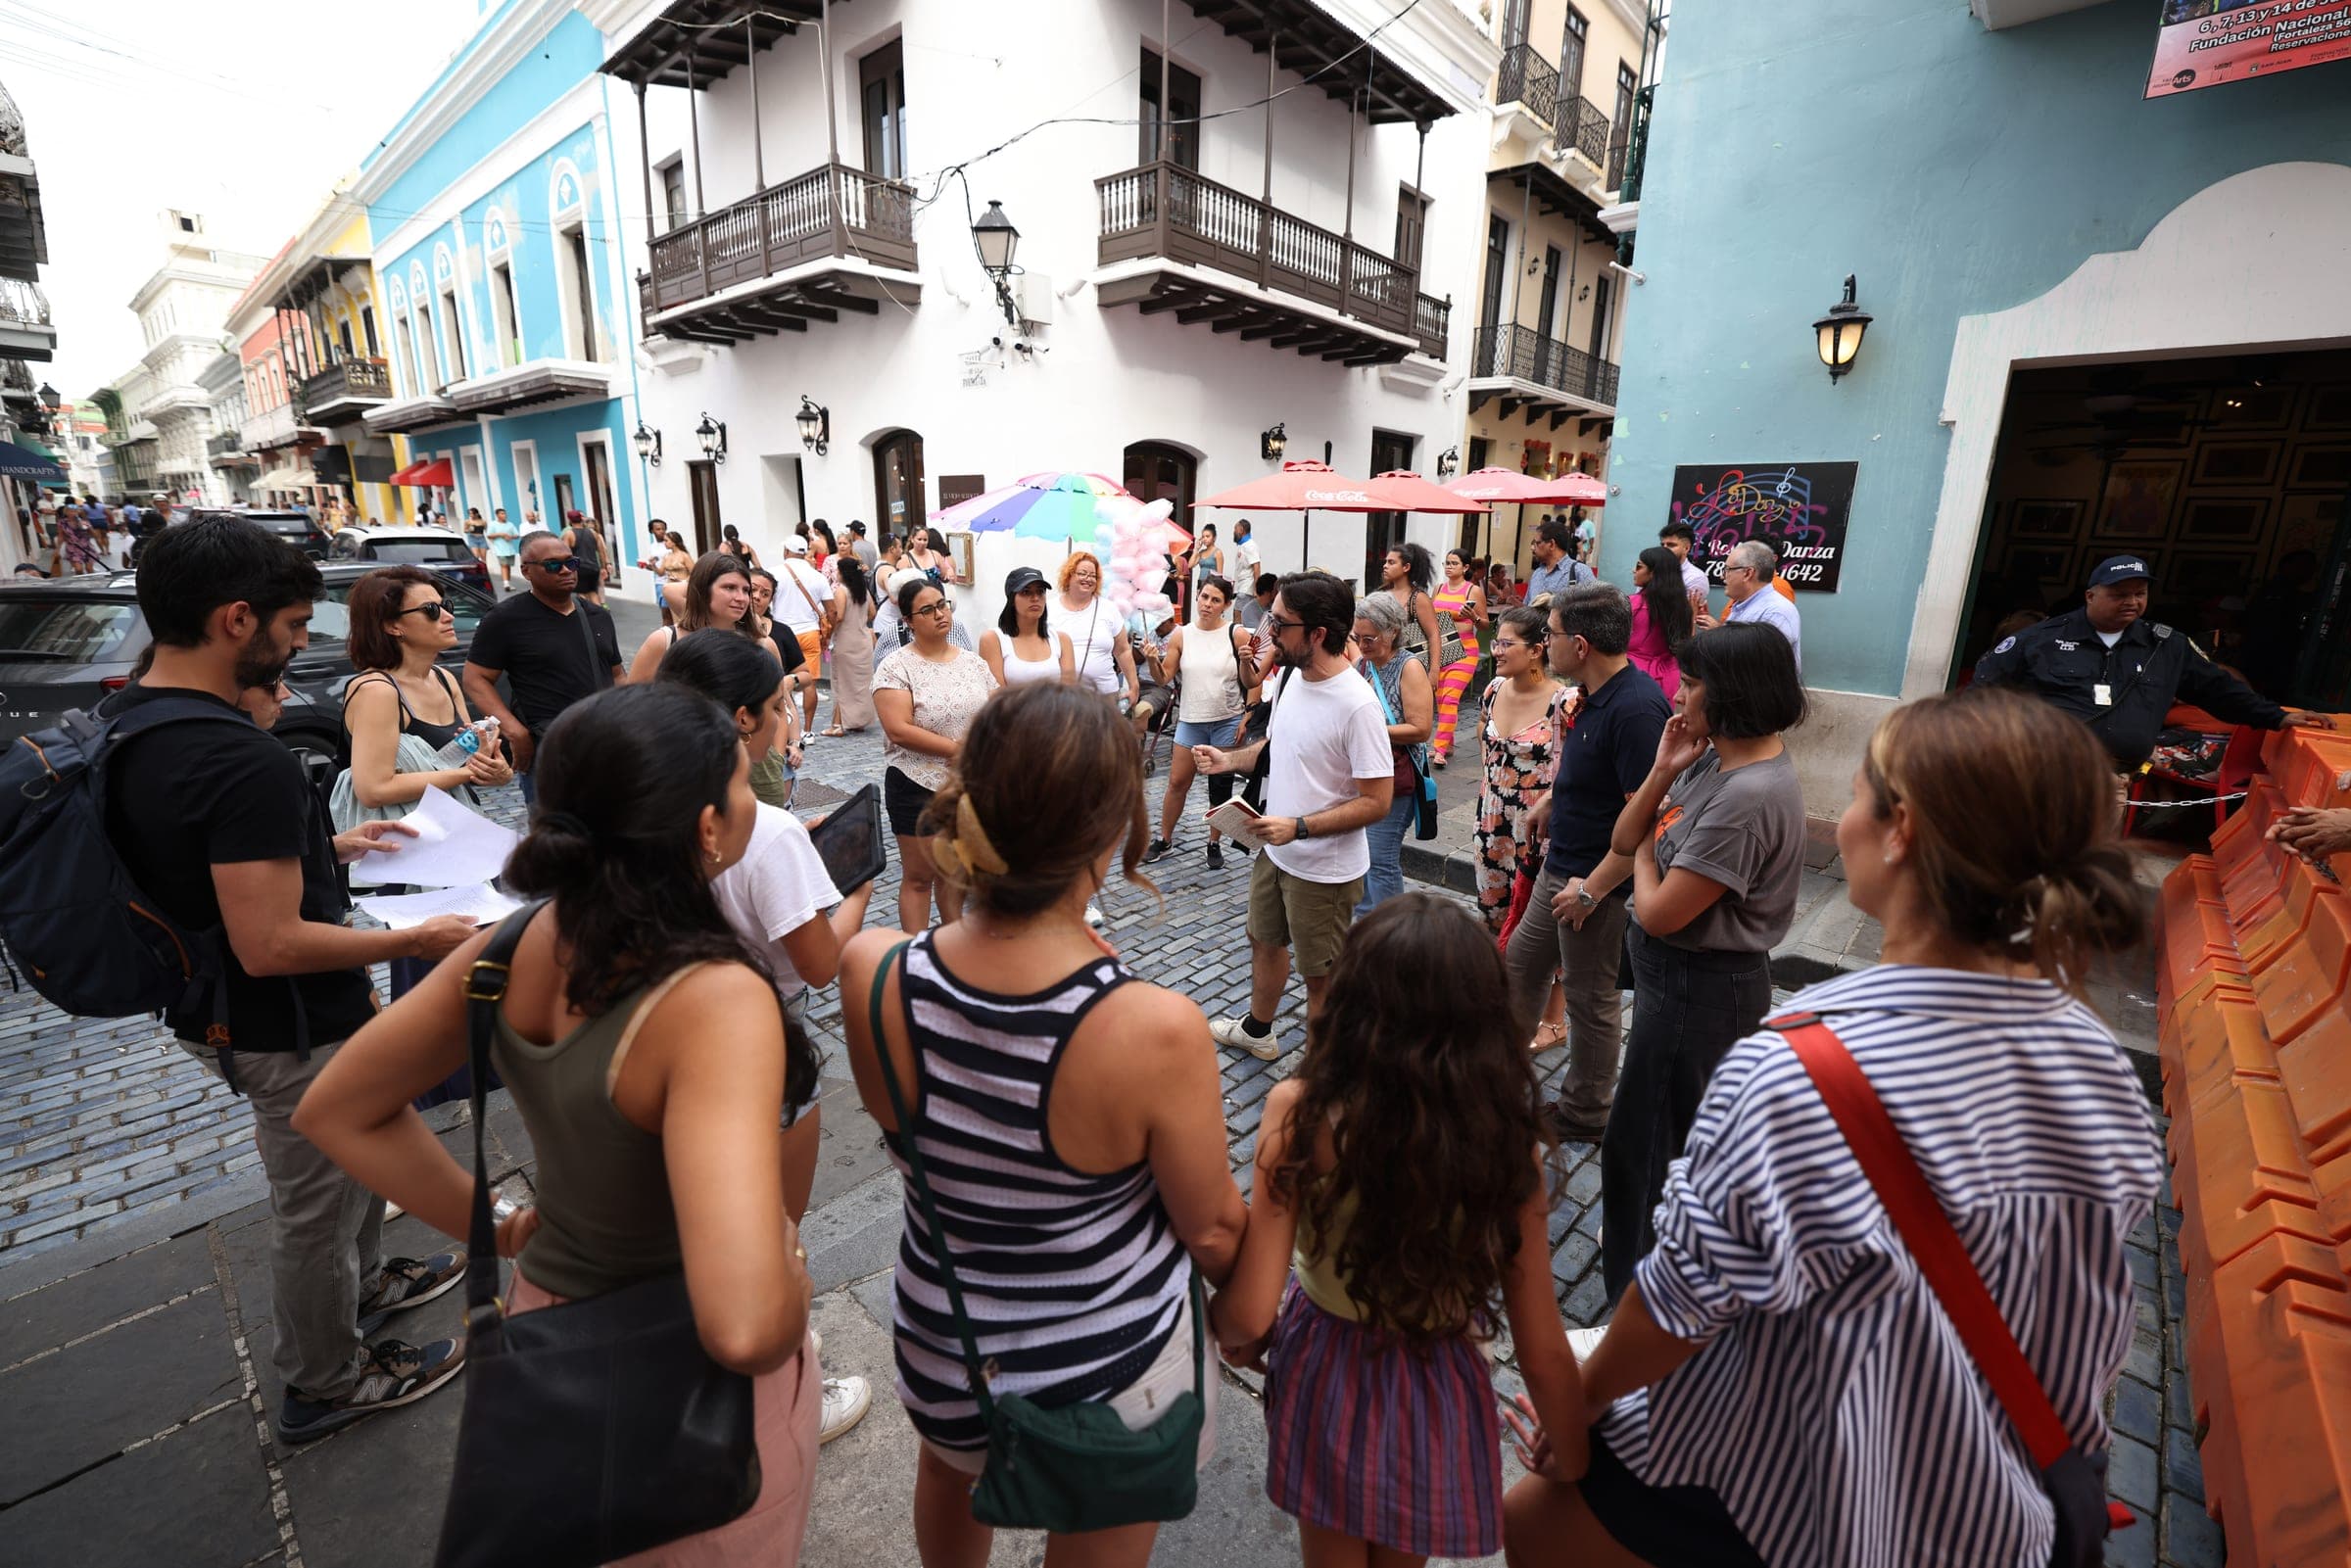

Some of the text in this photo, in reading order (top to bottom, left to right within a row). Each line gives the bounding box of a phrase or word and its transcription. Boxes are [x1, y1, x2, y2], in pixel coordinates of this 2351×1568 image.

[2237, 11, 2255, 24] 13
[2257, 9, 2270, 23] y
[2272, 3, 2292, 16] 14
[2295, 0, 2316, 11] de
[2189, 6, 2349, 52] Fundación Nacional
[2270, 29, 2351, 53] Reservacione
[2273, 24, 2333, 42] (Fortaleza
[1, 465, 56, 475] HANDCRAFTS
